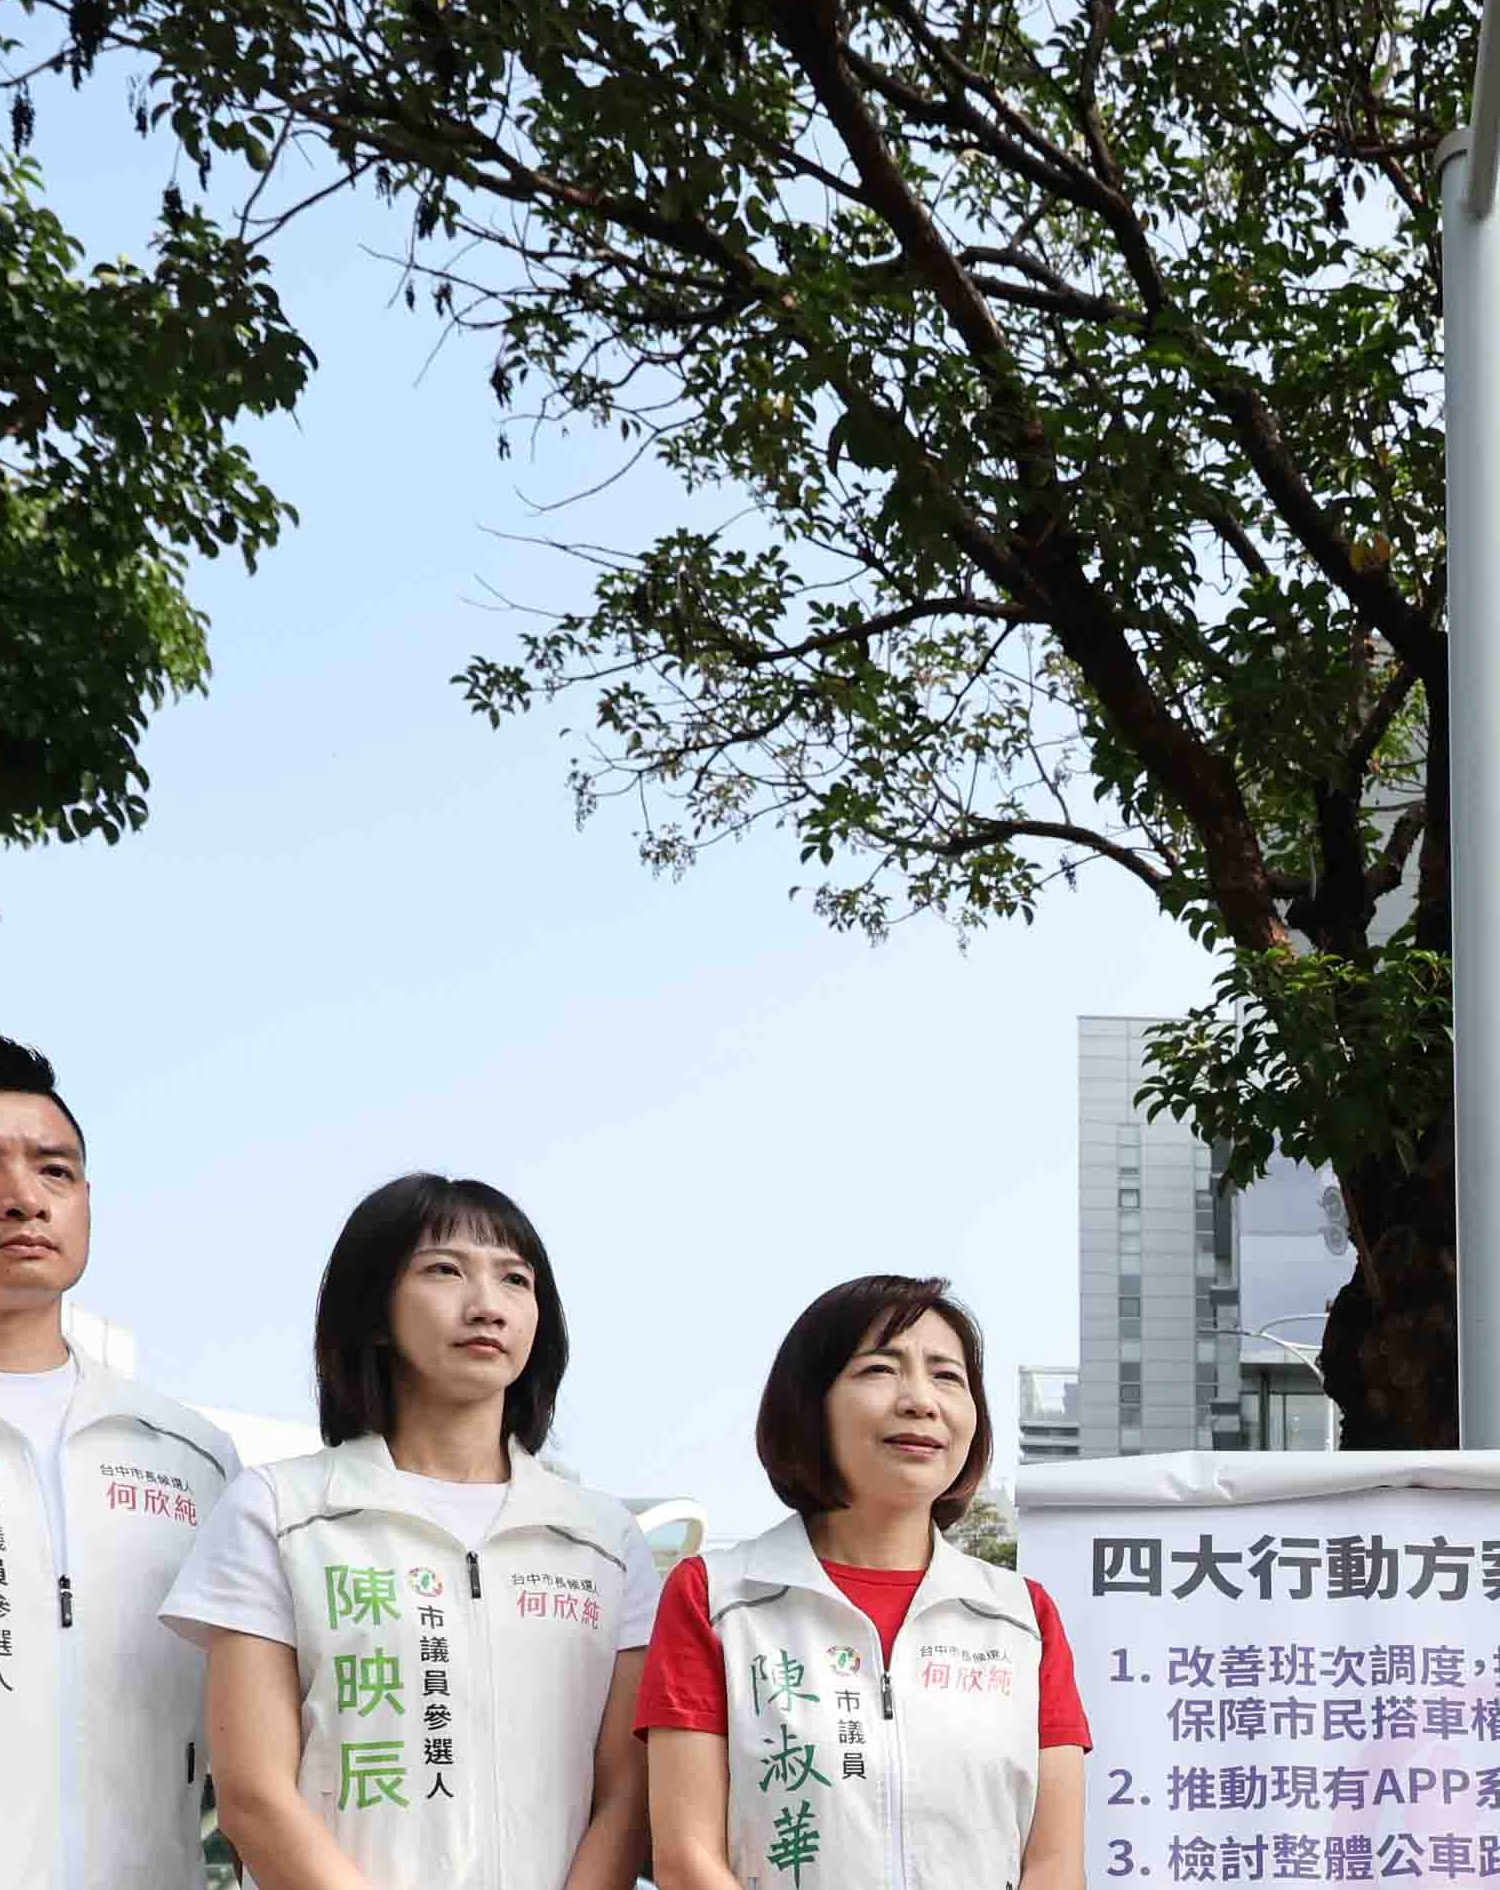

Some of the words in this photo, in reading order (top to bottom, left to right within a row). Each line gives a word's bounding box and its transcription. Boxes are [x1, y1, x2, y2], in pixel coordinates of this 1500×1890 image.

[108, 1481, 197, 1526] 何欣純
[517, 1589, 601, 1629] 何欣純
[922, 1661, 1012, 1697] 何欣純
[1109, 1647, 1151, 1684] 1.
[323, 1564, 411, 1812] 陳映辰
[417, 1605, 454, 1799] 市議員參選人
[834, 1690, 867, 1780] 市議員
[750, 1649, 833, 1890] 陳淑華
[1108, 1768, 1151, 1806] 2.
[1107, 1838, 1151, 1877] 3.
